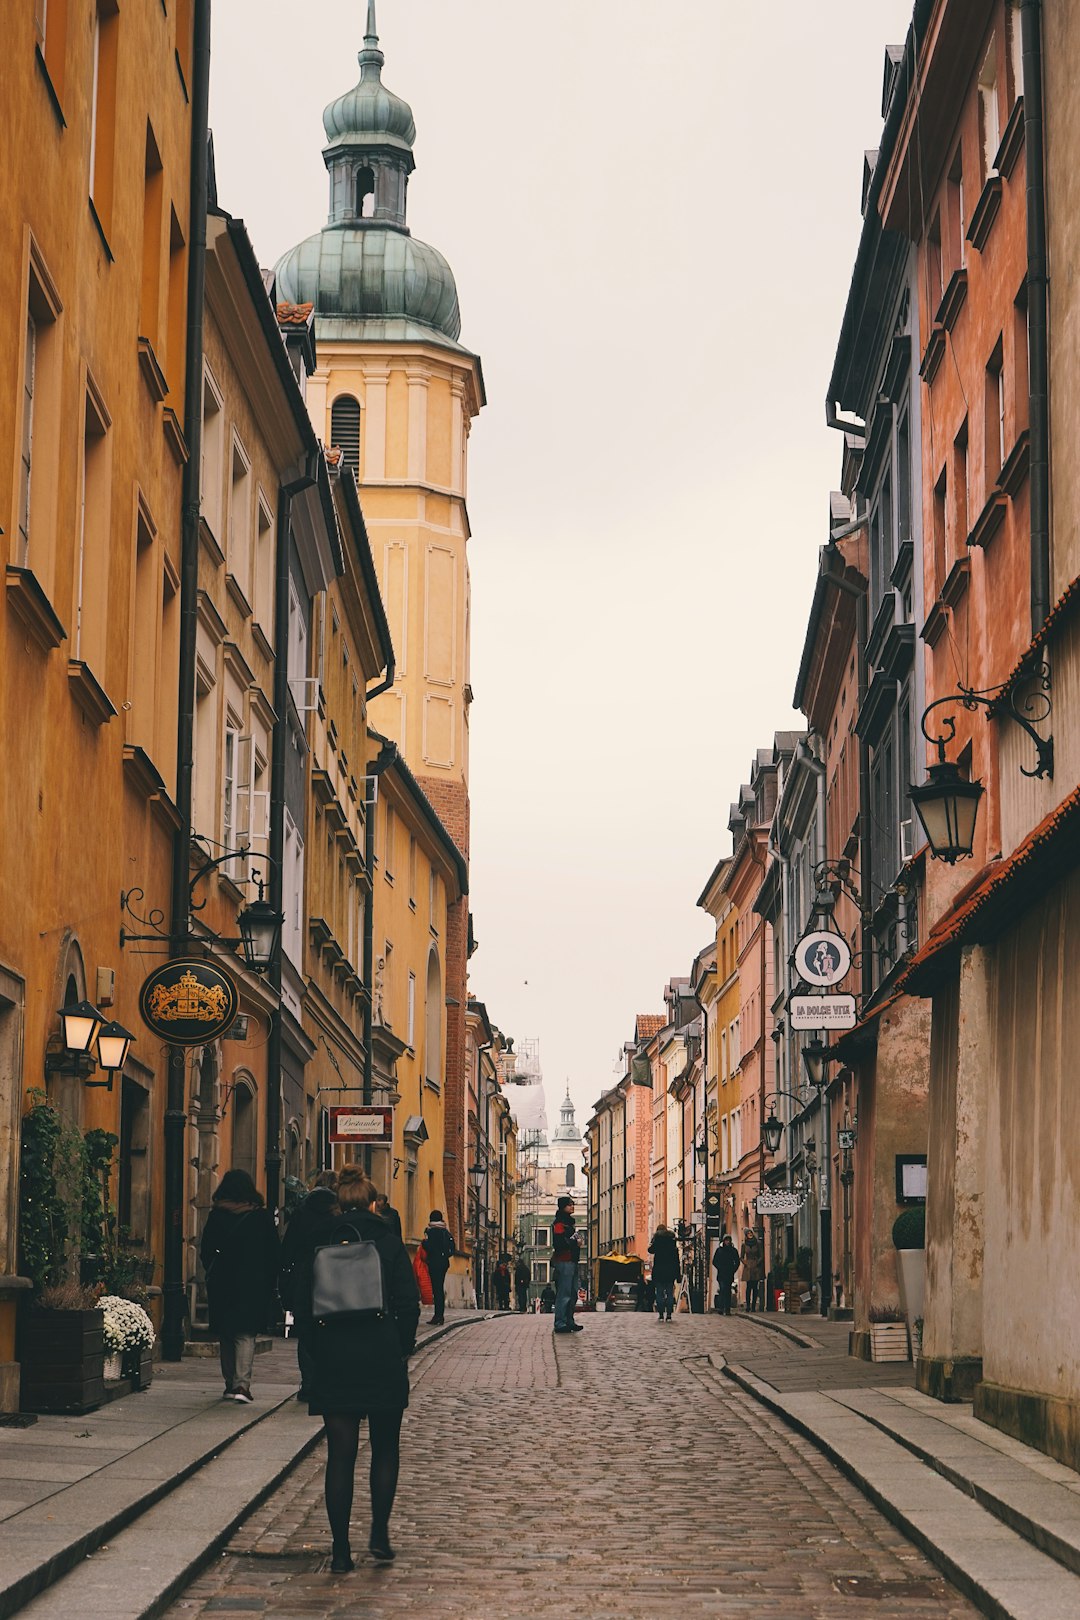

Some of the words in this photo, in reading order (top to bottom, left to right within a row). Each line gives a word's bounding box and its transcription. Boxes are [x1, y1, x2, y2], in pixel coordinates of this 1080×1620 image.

[796, 1006, 806, 1016] LA
[806, 1006, 832, 1016] DOLCE
[832, 1005, 850, 1014] VITA
